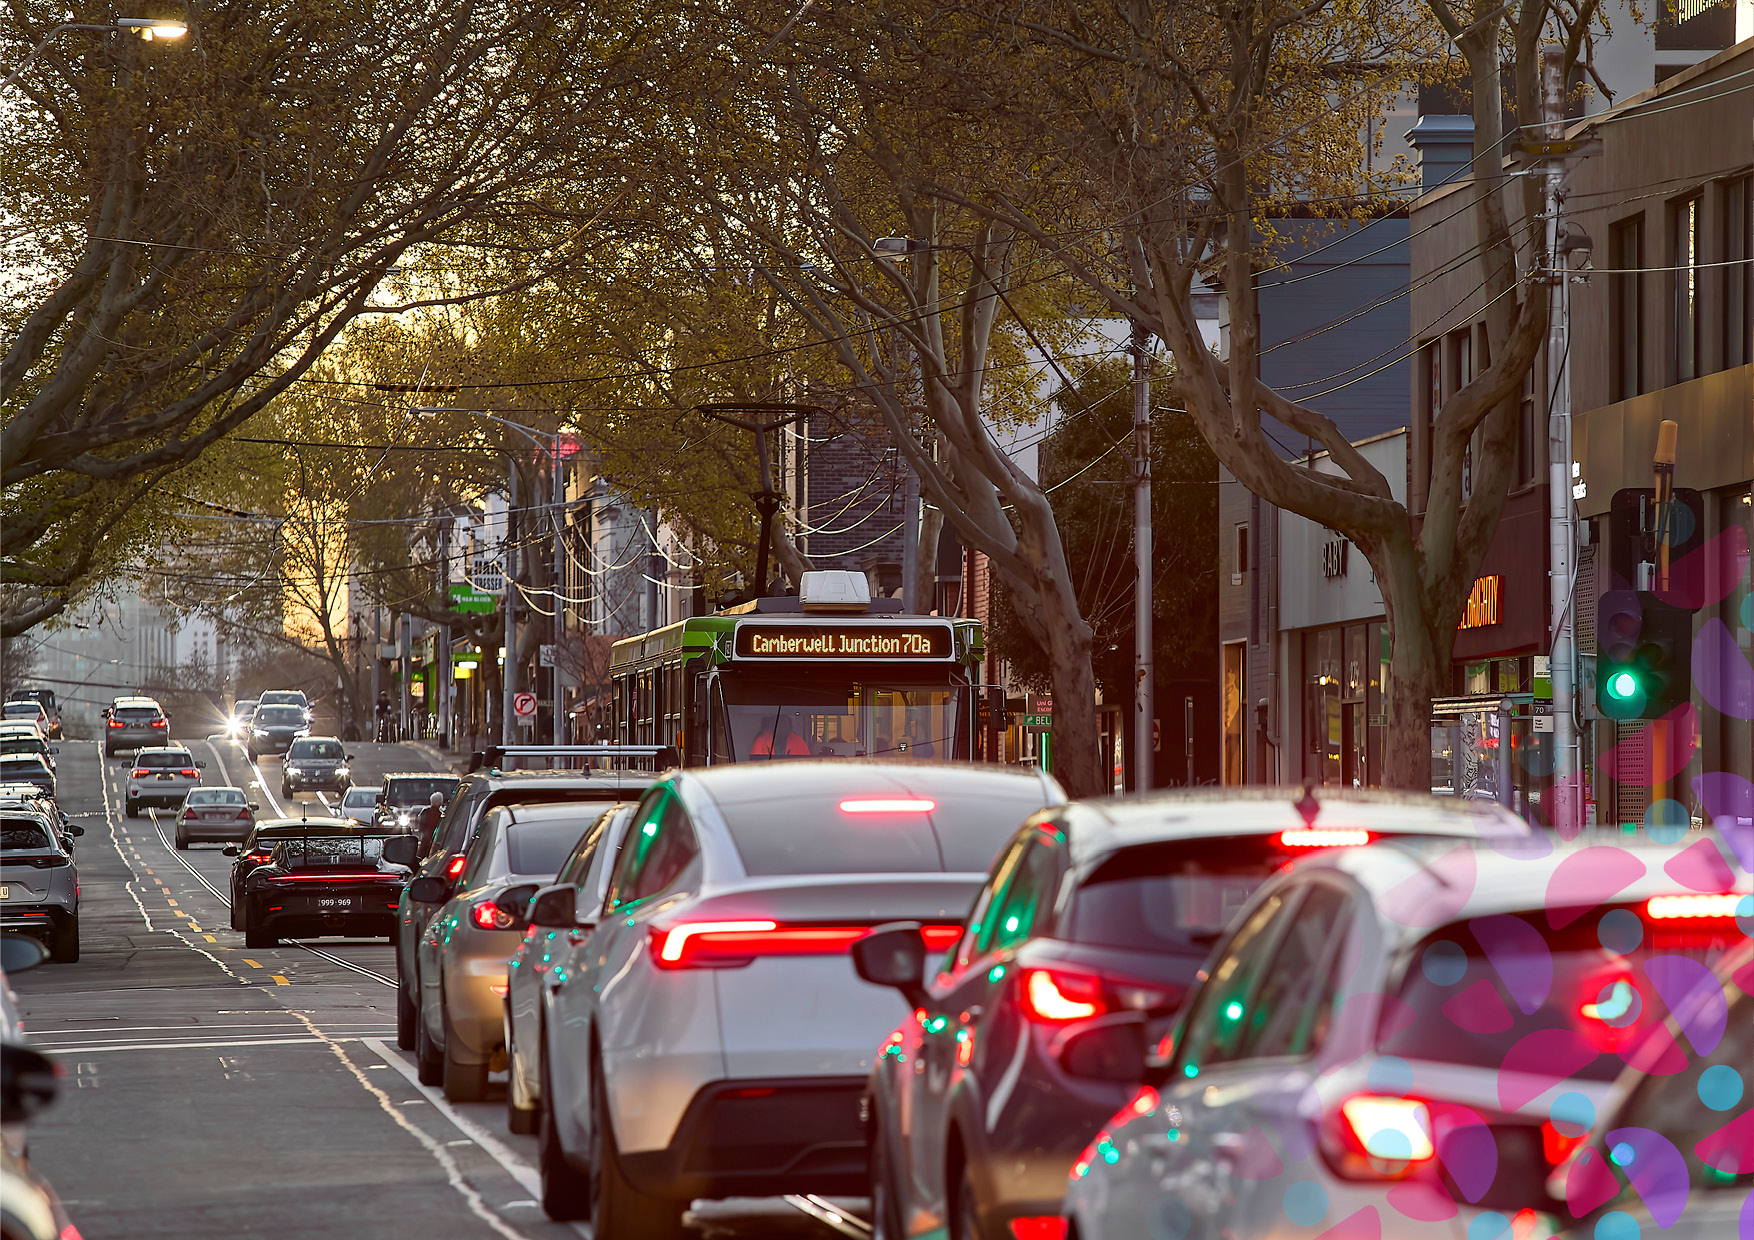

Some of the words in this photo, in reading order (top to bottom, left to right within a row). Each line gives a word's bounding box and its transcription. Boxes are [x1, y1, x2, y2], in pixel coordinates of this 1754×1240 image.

[1322, 540, 1344, 577] BABY
[752, 634, 835, 652] Camberwell
[838, 634, 900, 652] Junction
[901, 633, 931, 653] 70a
